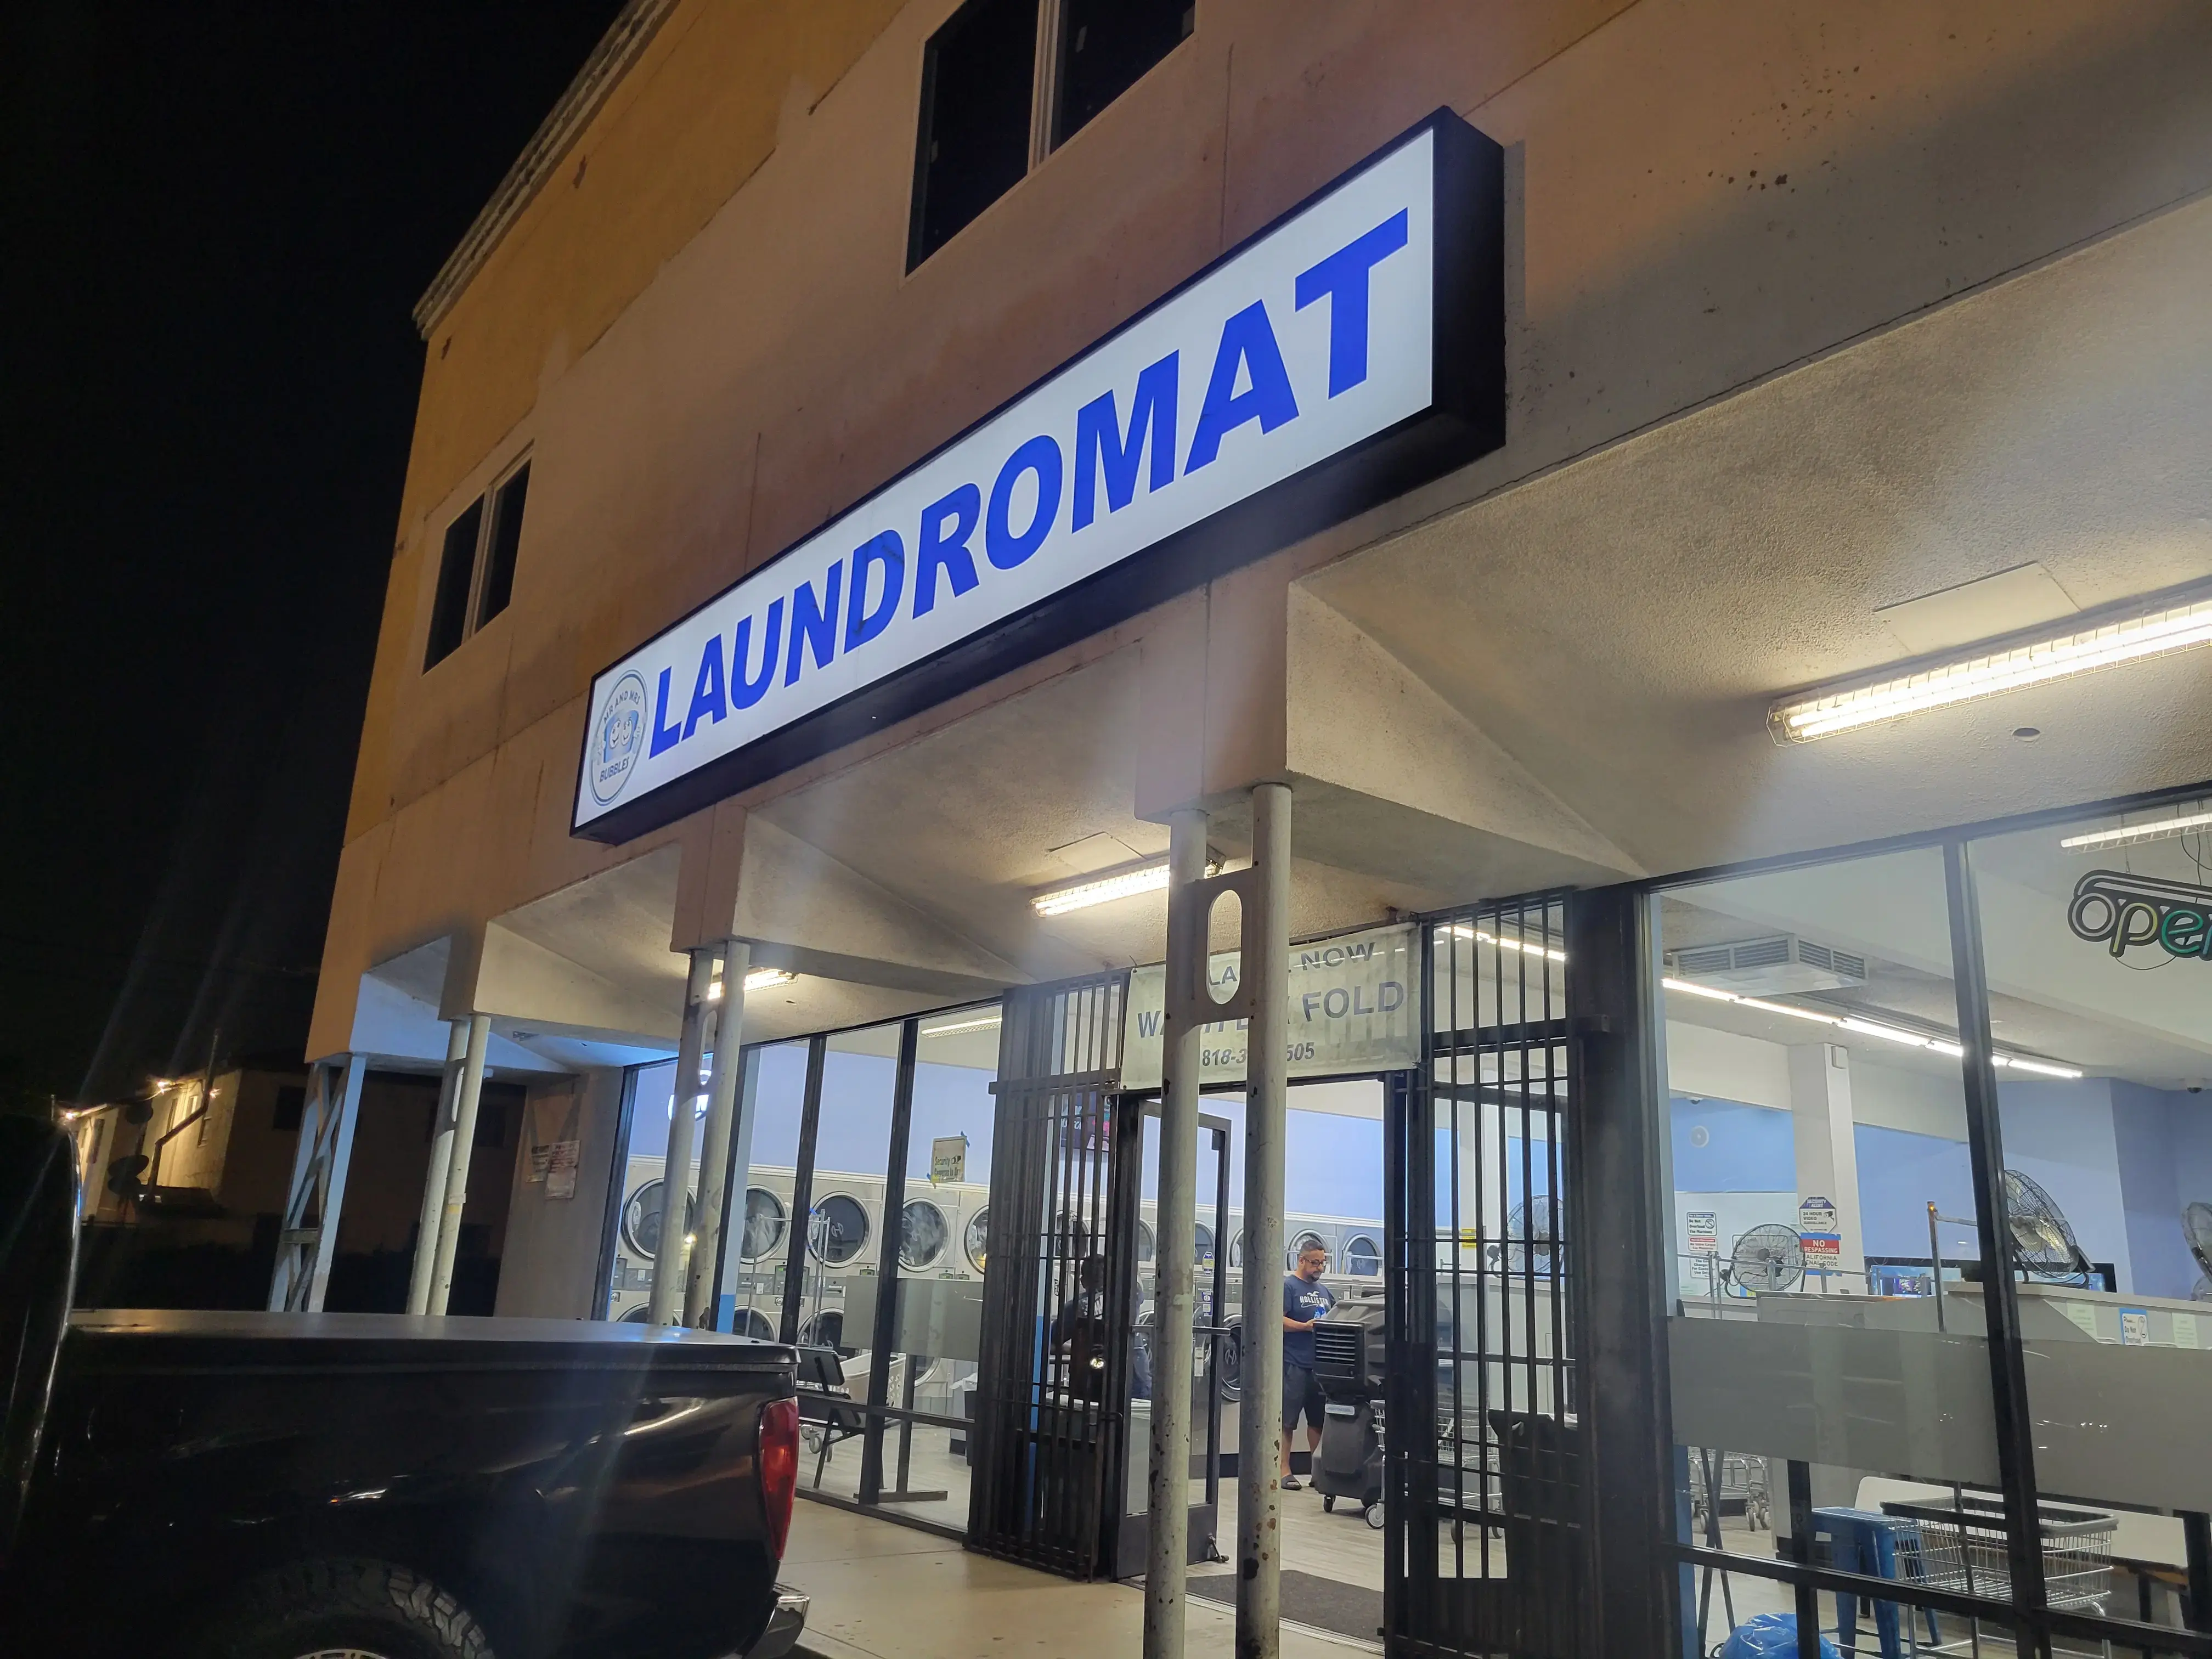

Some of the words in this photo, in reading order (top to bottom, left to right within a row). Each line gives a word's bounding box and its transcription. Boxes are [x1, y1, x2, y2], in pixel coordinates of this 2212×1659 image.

[649, 207, 1408, 760] LAUNDROMAT
[603, 704, 613, 724] MR
[614, 690, 628, 708] AND
[629, 690, 641, 706] MRS
[599, 756, 630, 783] BUBBLES
[1301, 942, 1375, 970] NOW
[1302, 981, 1404, 1022] FOLD
[1299, 1295, 1329, 1306] HOLLISTER
